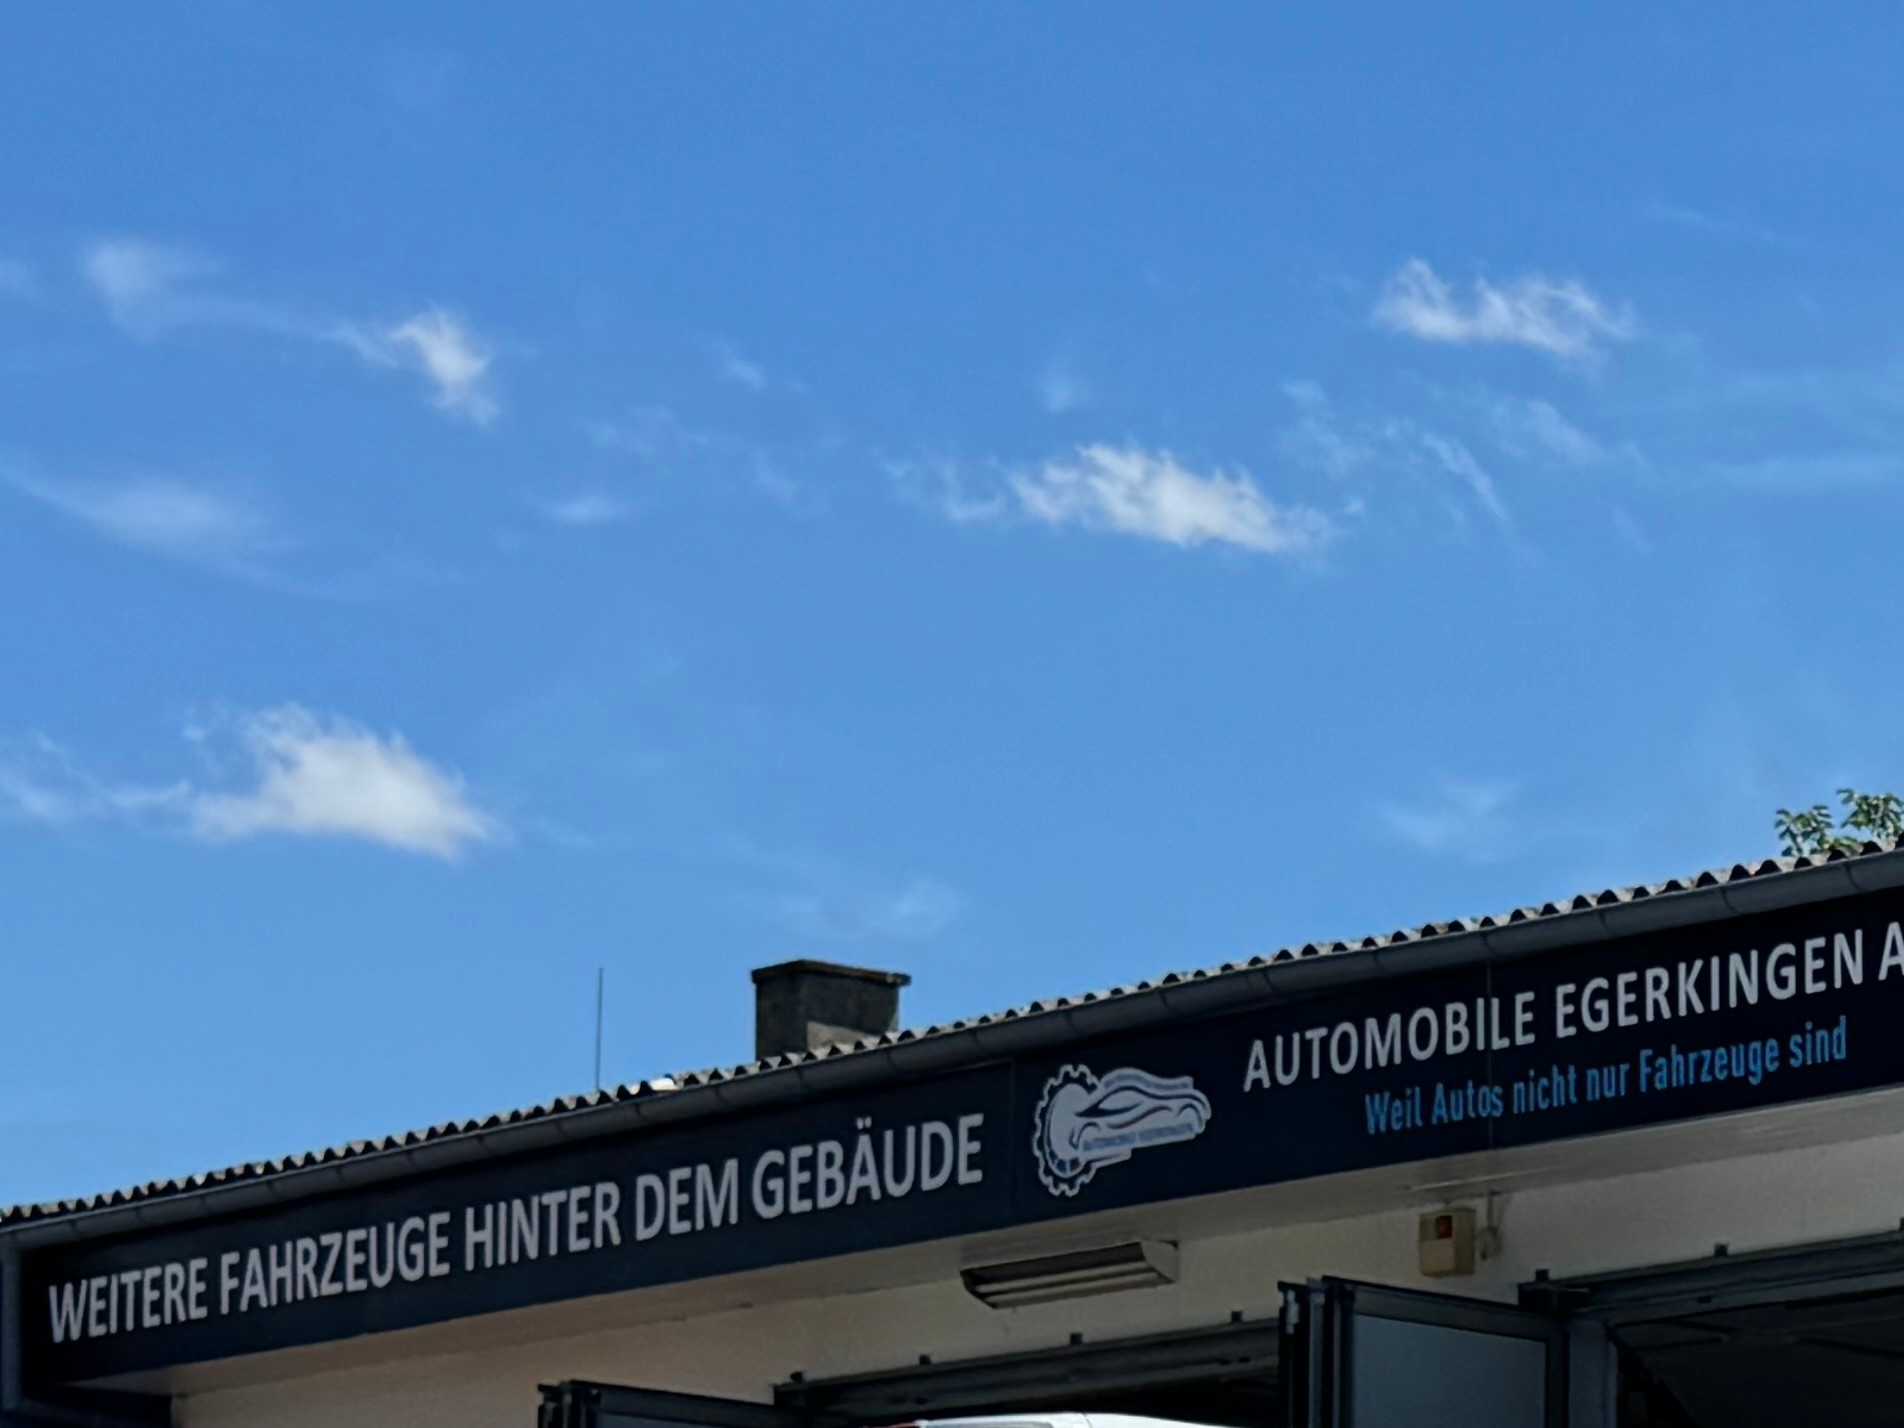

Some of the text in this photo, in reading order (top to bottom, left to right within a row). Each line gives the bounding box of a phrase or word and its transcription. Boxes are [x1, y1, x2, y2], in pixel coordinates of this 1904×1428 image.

[1242, 991, 1537, 1093] AUTOMOBILE
[1555, 928, 1865, 1038] EGERKINGEN
[1363, 1015, 1848, 1136] Weil Autos nicht nur Fahrzeuge sind
[49, 1113, 985, 1343] WEITERE FAHRZEUGE HINTER DEM GEBÄUDE
